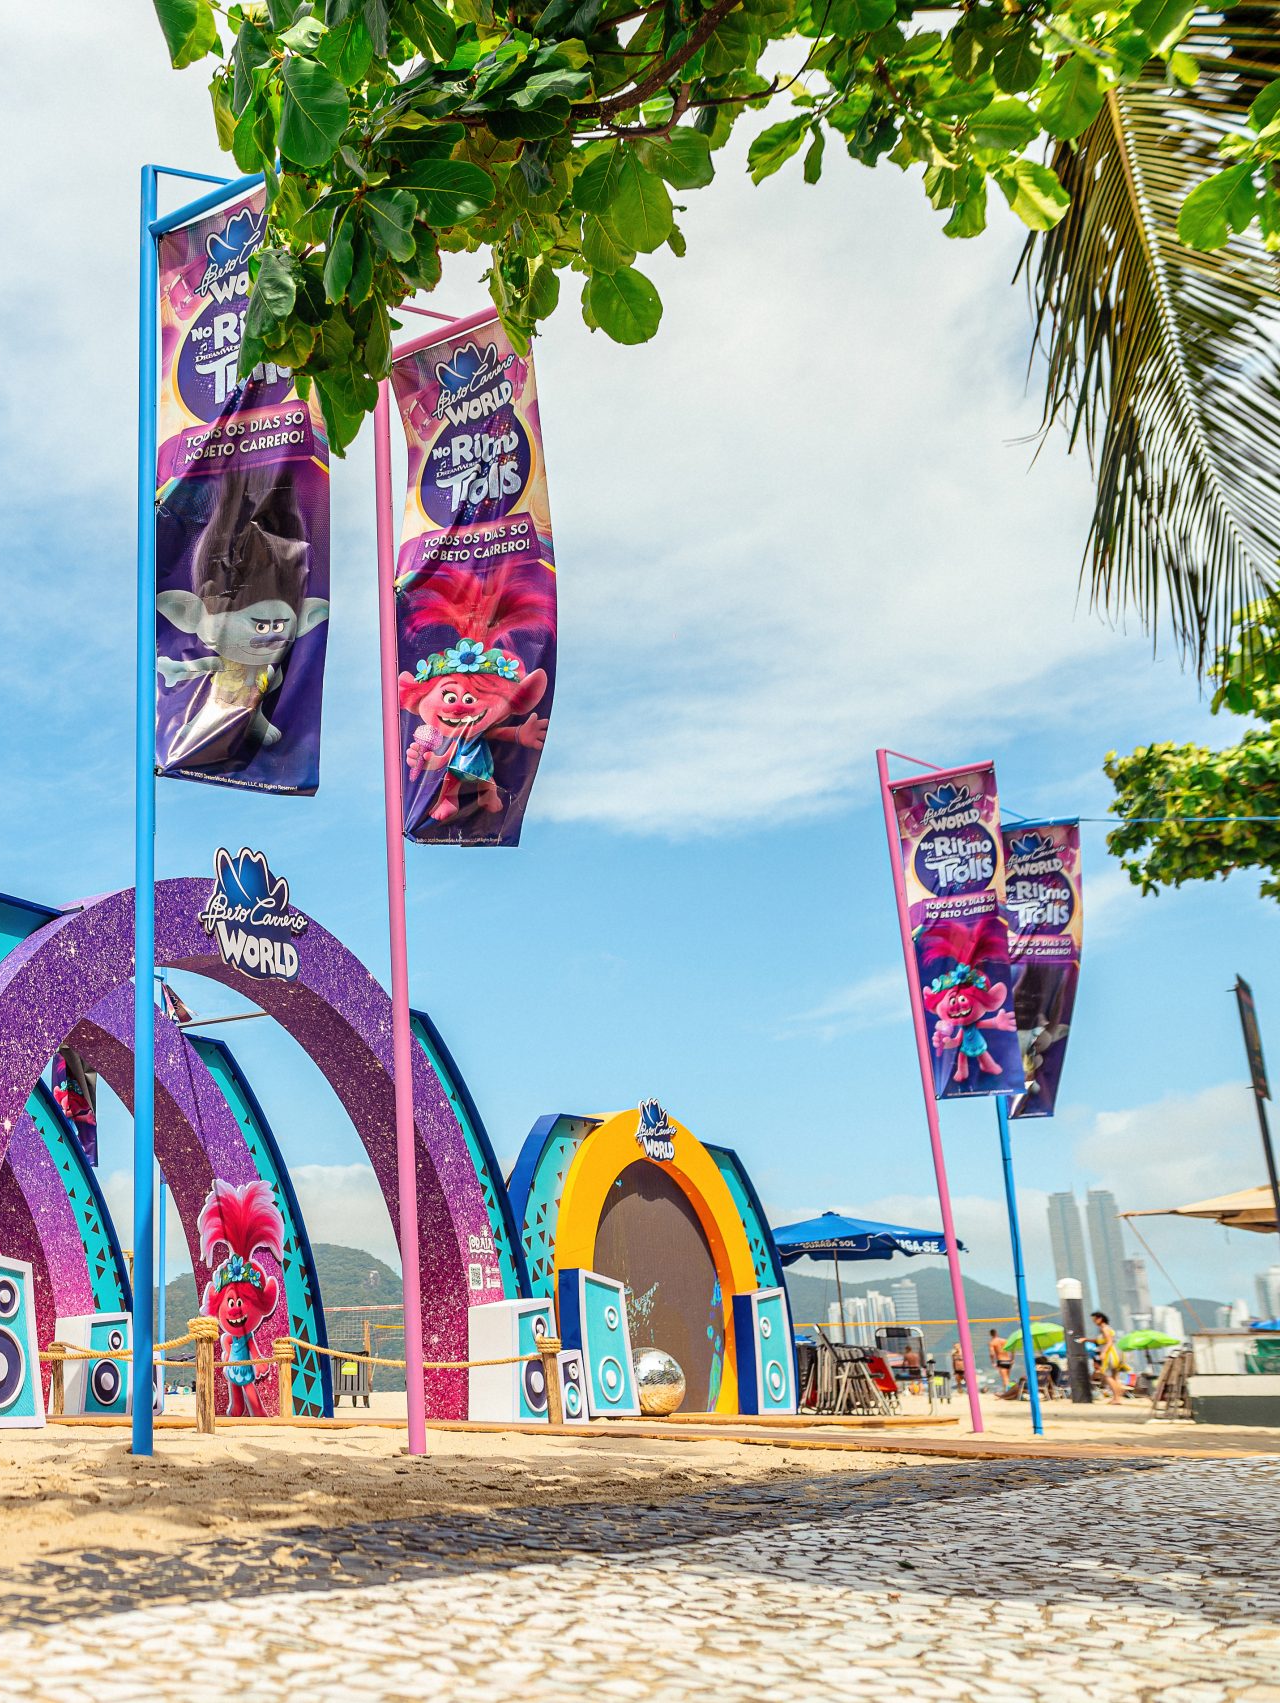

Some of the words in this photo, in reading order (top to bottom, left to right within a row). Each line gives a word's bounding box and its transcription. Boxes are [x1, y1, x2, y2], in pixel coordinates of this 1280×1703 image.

[432, 383, 470, 419] Beto
[470, 354, 515, 392] Carrero
[445, 381, 512, 427] WORLD
[225, 422, 246, 437] OS
[250, 416, 280, 433] DIAS
[284, 408, 304, 426] SÓ
[240, 431, 305, 453] CARRERO!
[421, 549, 439, 561] NO
[440, 549, 470, 561] BETO
[473, 538, 530, 559] CARRERO!
[424, 535, 460, 548] TODOS
[463, 532, 480, 545] OS
[929, 808, 980, 832] WORLD
[934, 836, 993, 857] Ritmo
[925, 857, 994, 888] Trolls
[1012, 858, 1063, 876] WORLD
[1016, 881, 1071, 902] Ritmo
[201, 891, 250, 931] Beto
[250, 896, 308, 930] Carrero
[925, 901, 953, 910] TODOS
[955, 900, 967, 908] OS
[925, 911, 939, 919] NO
[940, 909, 961, 919] BETO
[1006, 902, 1070, 928] Trolls
[217, 920, 299, 978] WORLD
[642, 1136, 675, 1159] WORLD
